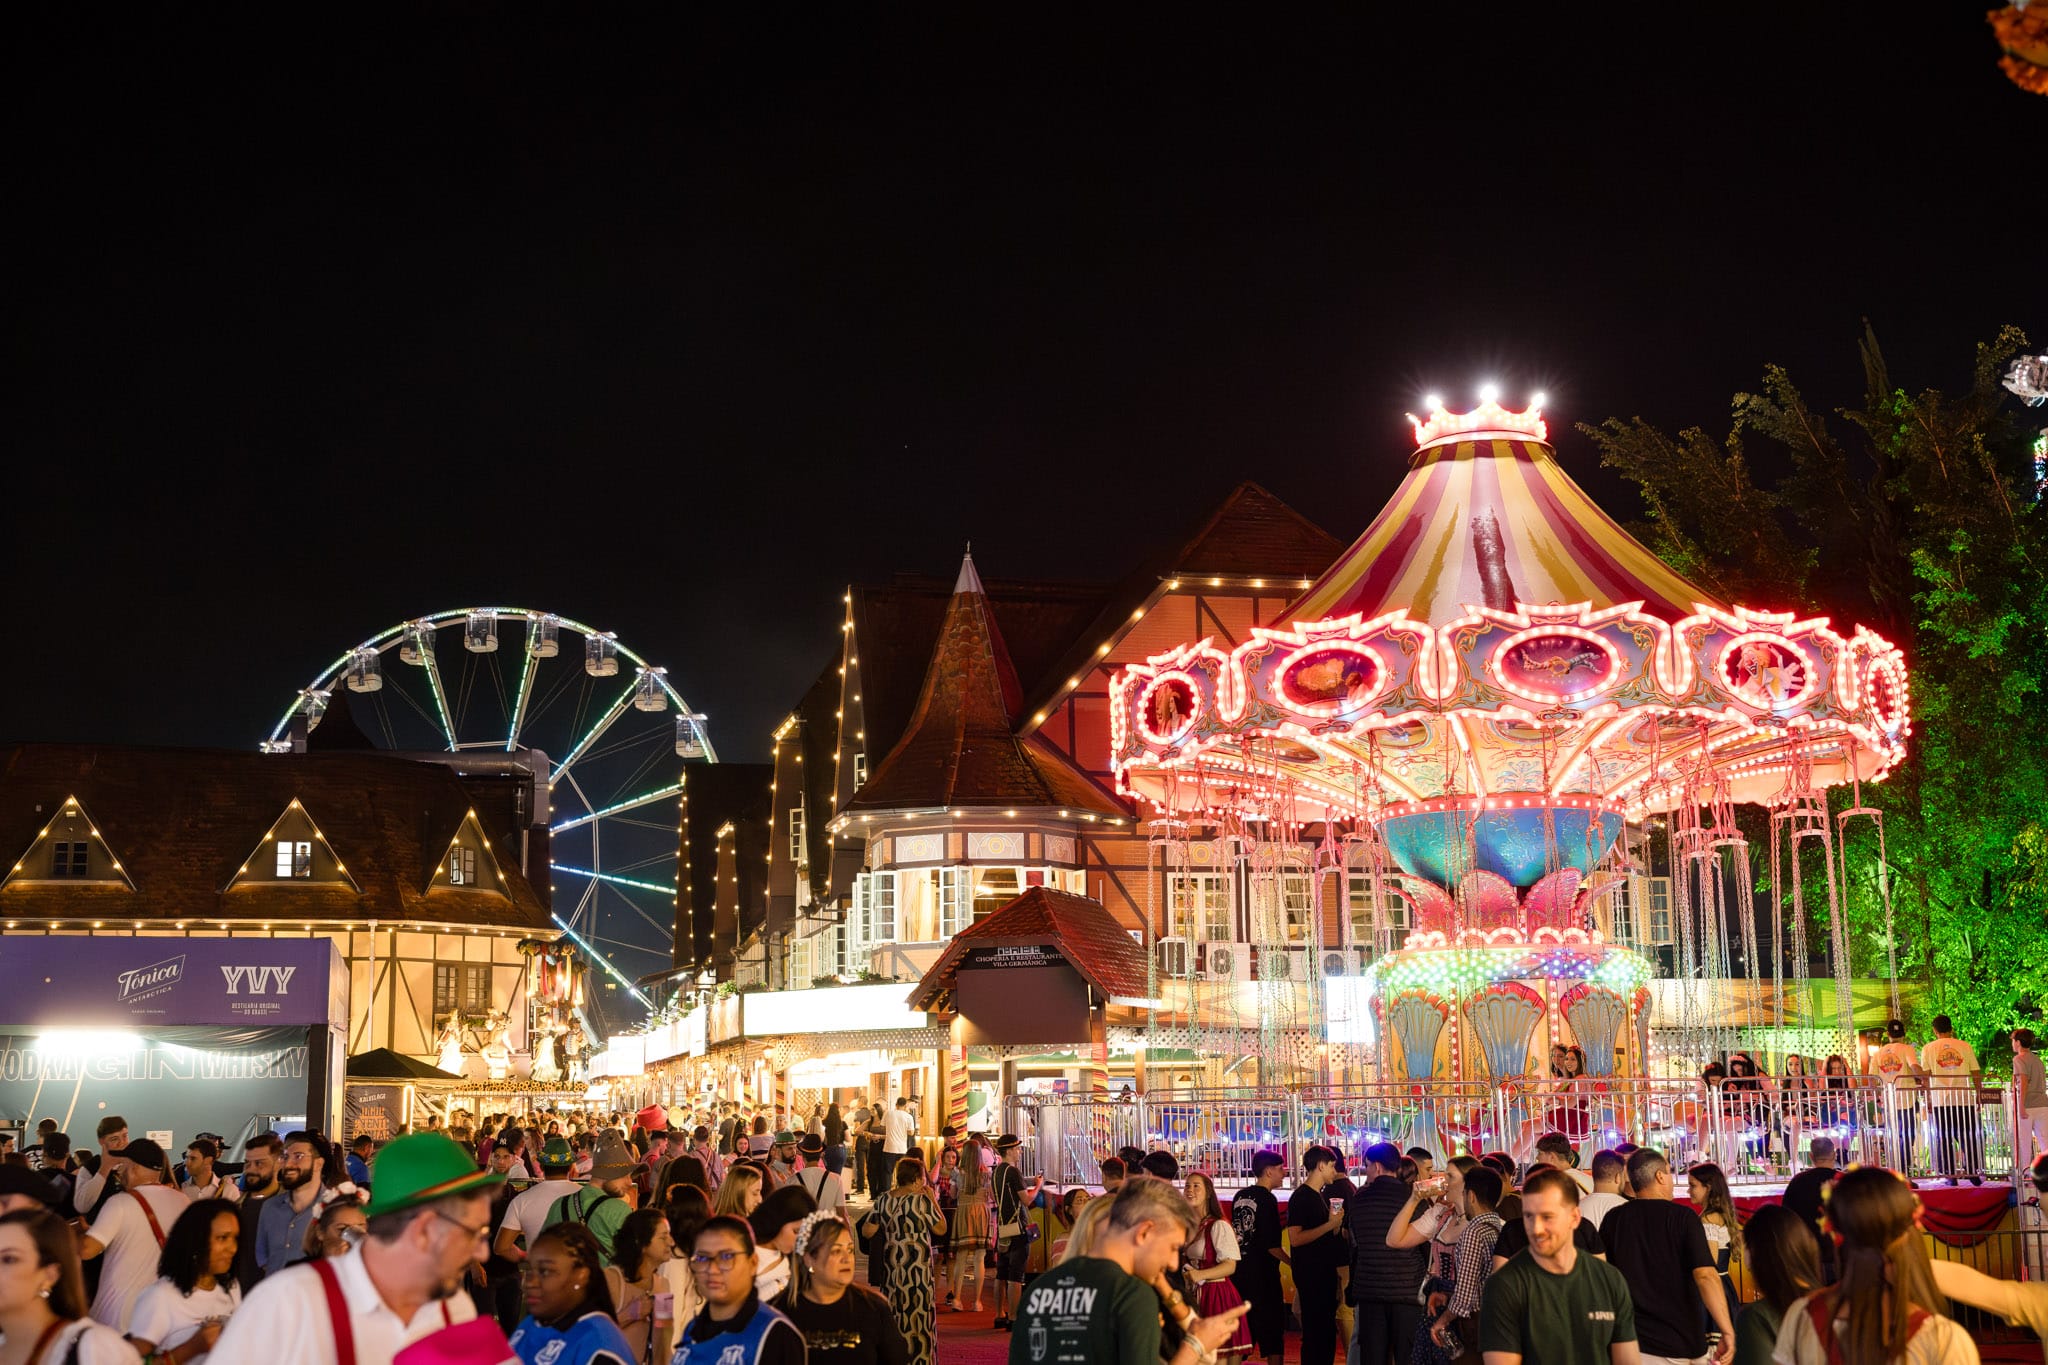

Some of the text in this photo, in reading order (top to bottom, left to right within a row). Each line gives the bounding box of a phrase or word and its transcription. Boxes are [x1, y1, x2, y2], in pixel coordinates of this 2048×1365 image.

[220, 966, 297, 995] YVY
[128, 986, 172, 1004] ANTARCTICA
[84, 1048, 195, 1080] GIN
[200, 1046, 308, 1079] WHISKY
[1038, 1082, 1051, 1090] Red
[1026, 1287, 1098, 1315] SPATEN
